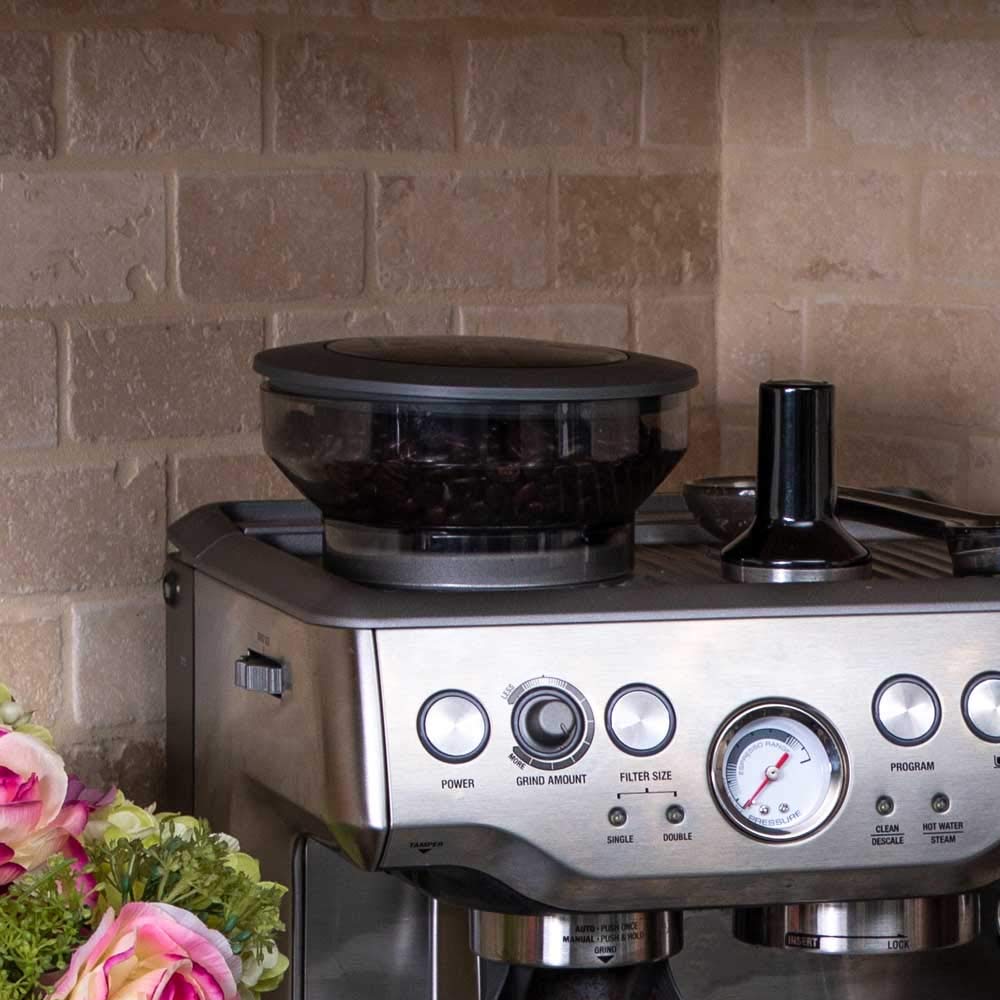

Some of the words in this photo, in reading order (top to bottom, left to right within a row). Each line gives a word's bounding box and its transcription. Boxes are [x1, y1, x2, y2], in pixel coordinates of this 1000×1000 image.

[508, 753, 526, 770] MORE
[890, 761, 935, 772] PROGRAM
[516, 776, 545, 786] GRIND
[547, 774, 587, 785] AMOUNT
[620, 771, 650, 782] FILTER
[652, 770, 672, 781] SIZE
[441, 779, 475, 789] POWER
[748, 809, 801, 826] PRESSURE
[875, 824, 899, 833] CLEAN
[922, 822, 937, 831] HOT
[938, 822, 963, 830] WATER
[607, 835, 634, 844] SINGLE
[663, 832, 693, 842] DOUBLE
[872, 837, 904, 846] DESCALE
[931, 835, 956, 844] STEAM
[575, 925, 595, 933] AUTO
[601, 924, 619, 932] PUSH
[563, 935, 595, 943] MANUAL
[601, 934, 619, 942] PUSH
[627, 931, 644, 940] HOLD
[787, 935, 818, 946] INSERT
[887, 940, 910, 949] LOCK
[594, 946, 617, 954] GRIND
